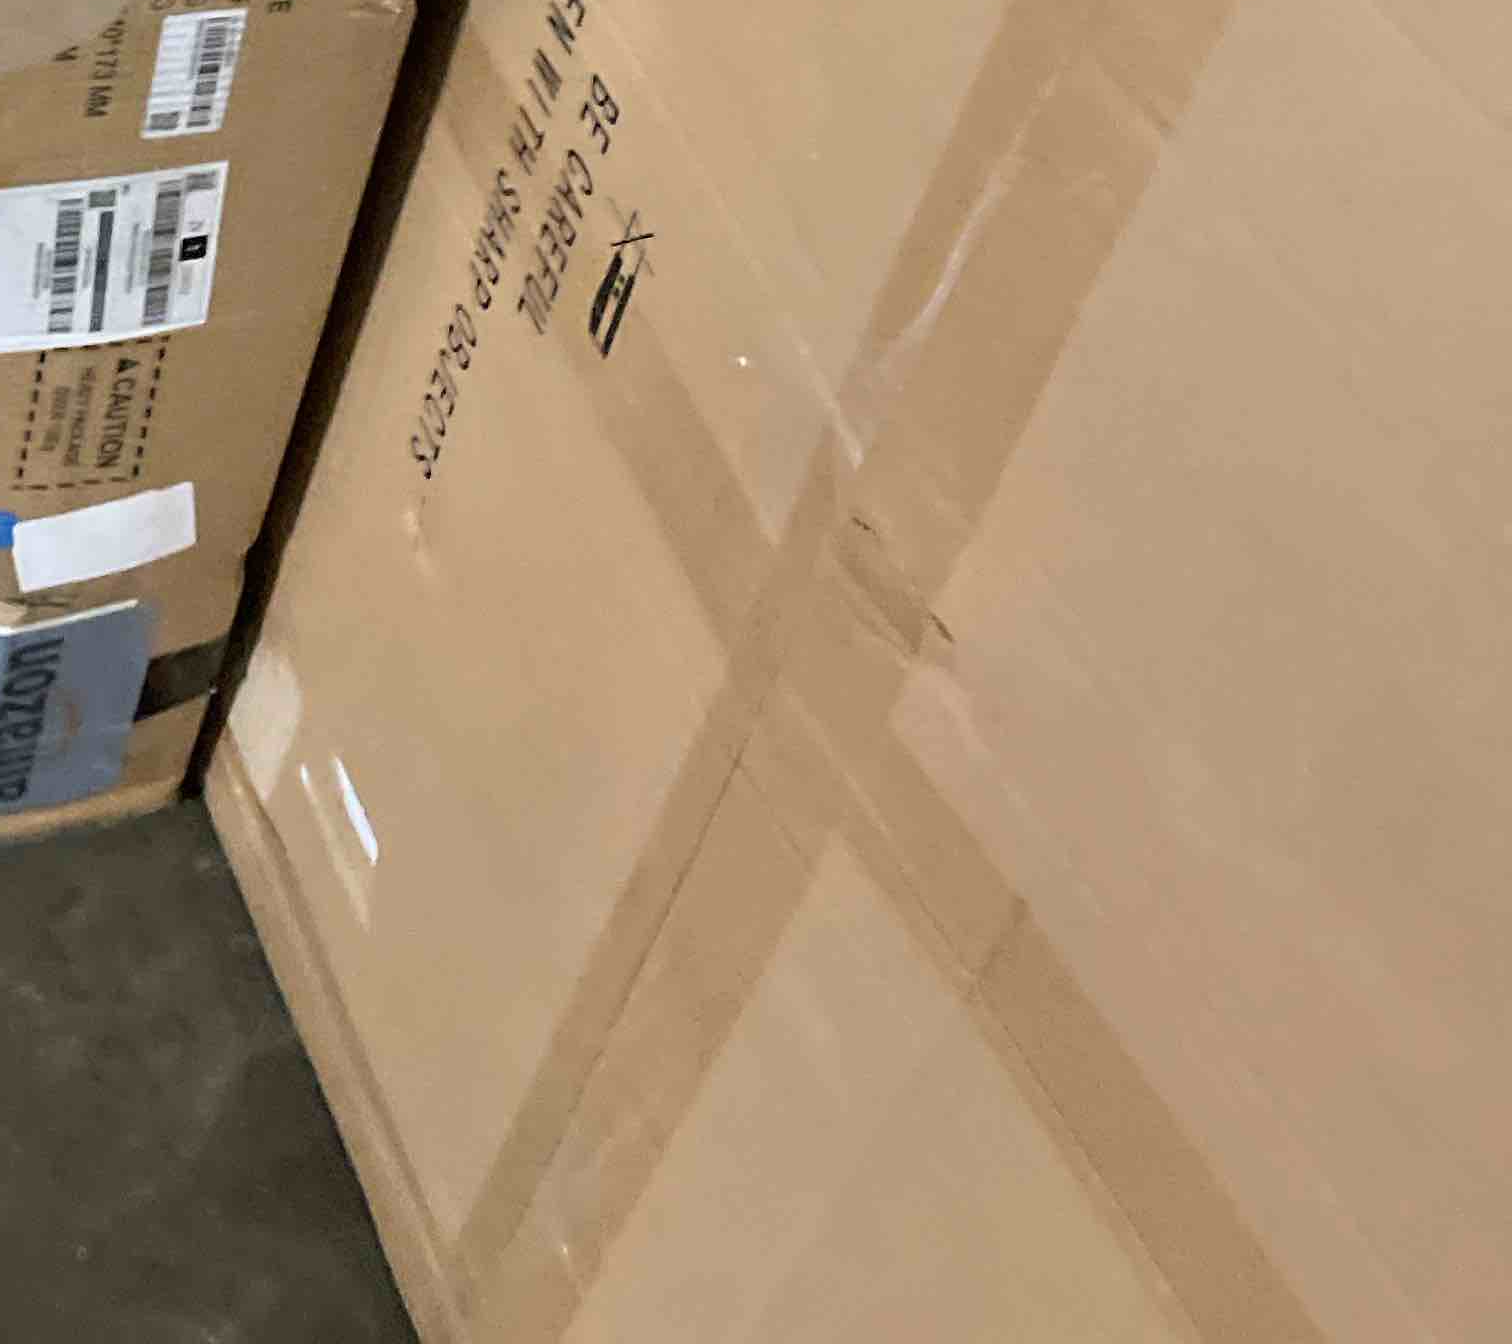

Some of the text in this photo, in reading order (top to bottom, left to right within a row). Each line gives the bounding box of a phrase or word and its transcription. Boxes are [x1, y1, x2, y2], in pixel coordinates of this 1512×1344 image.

[509, 48, 563, 177] WITH
[470, 168, 522, 311] SHARP
[517, 74, 621, 336] BE CAREFUL
[95, 377, 136, 469] CAUTION
[410, 302, 478, 481] OBJECTS
